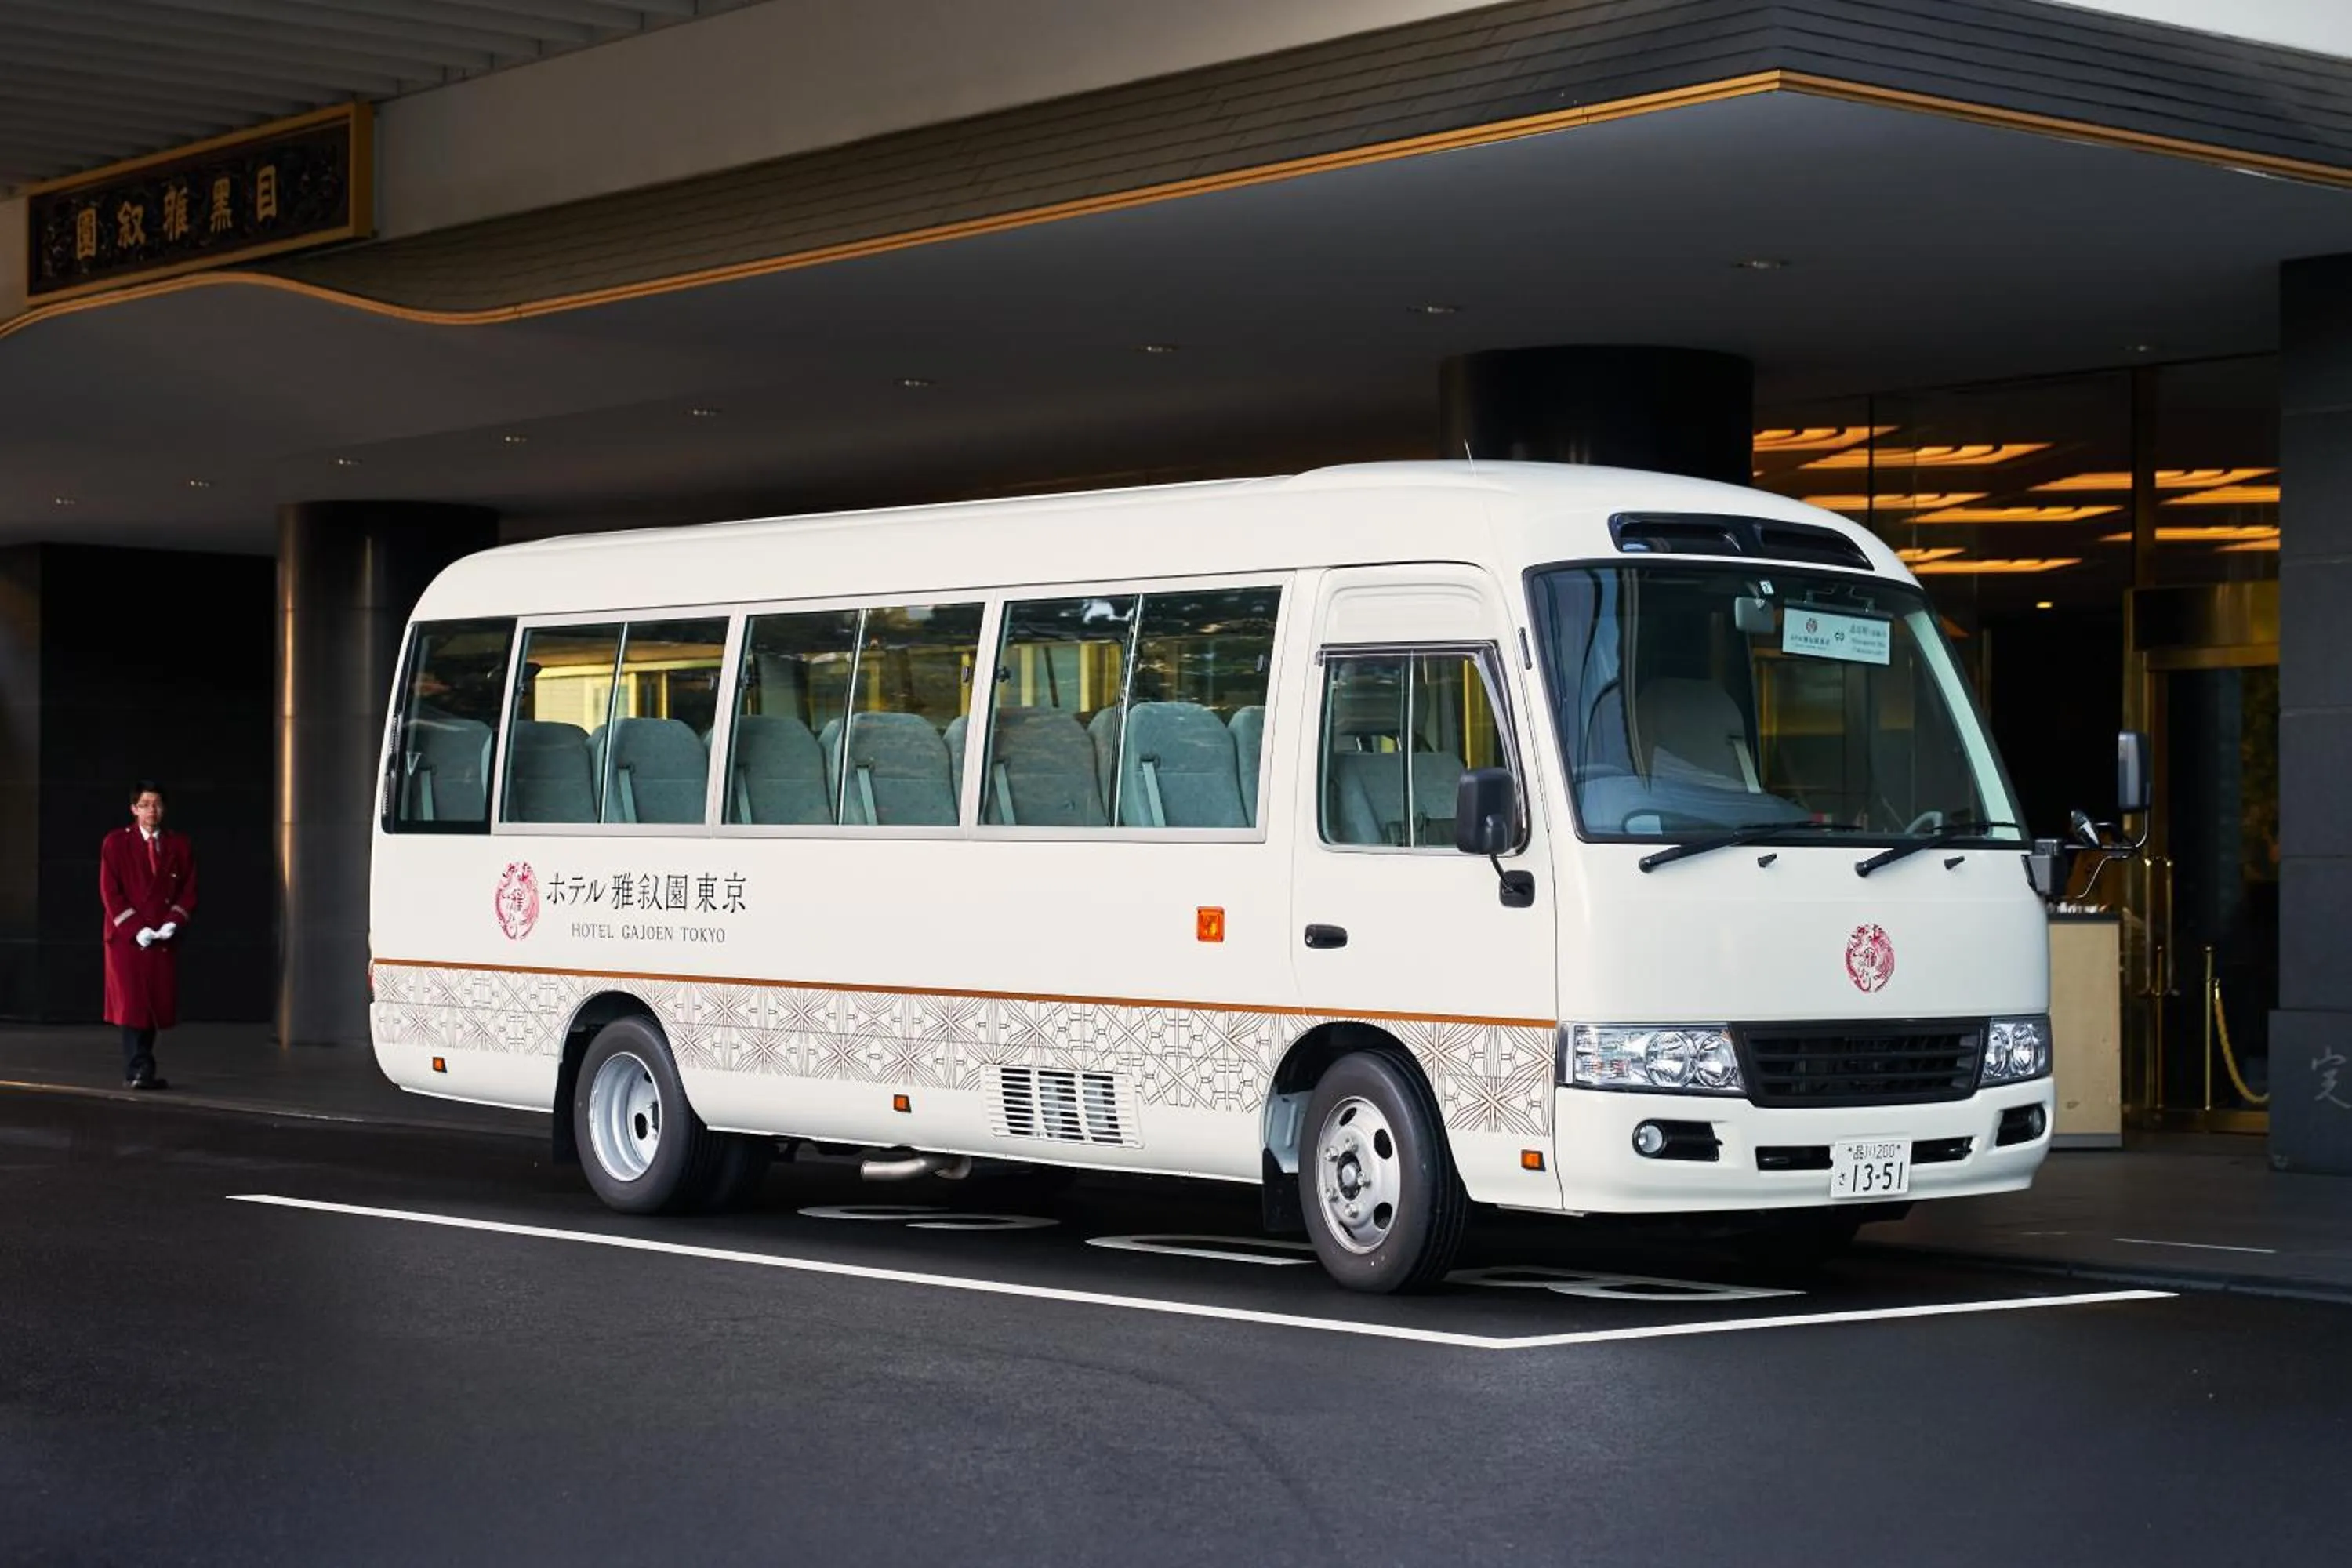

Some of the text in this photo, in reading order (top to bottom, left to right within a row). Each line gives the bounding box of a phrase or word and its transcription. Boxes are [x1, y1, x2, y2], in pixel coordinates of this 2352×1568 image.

[572, 923, 726, 943] HOTEL GAJOEN TOKYO
